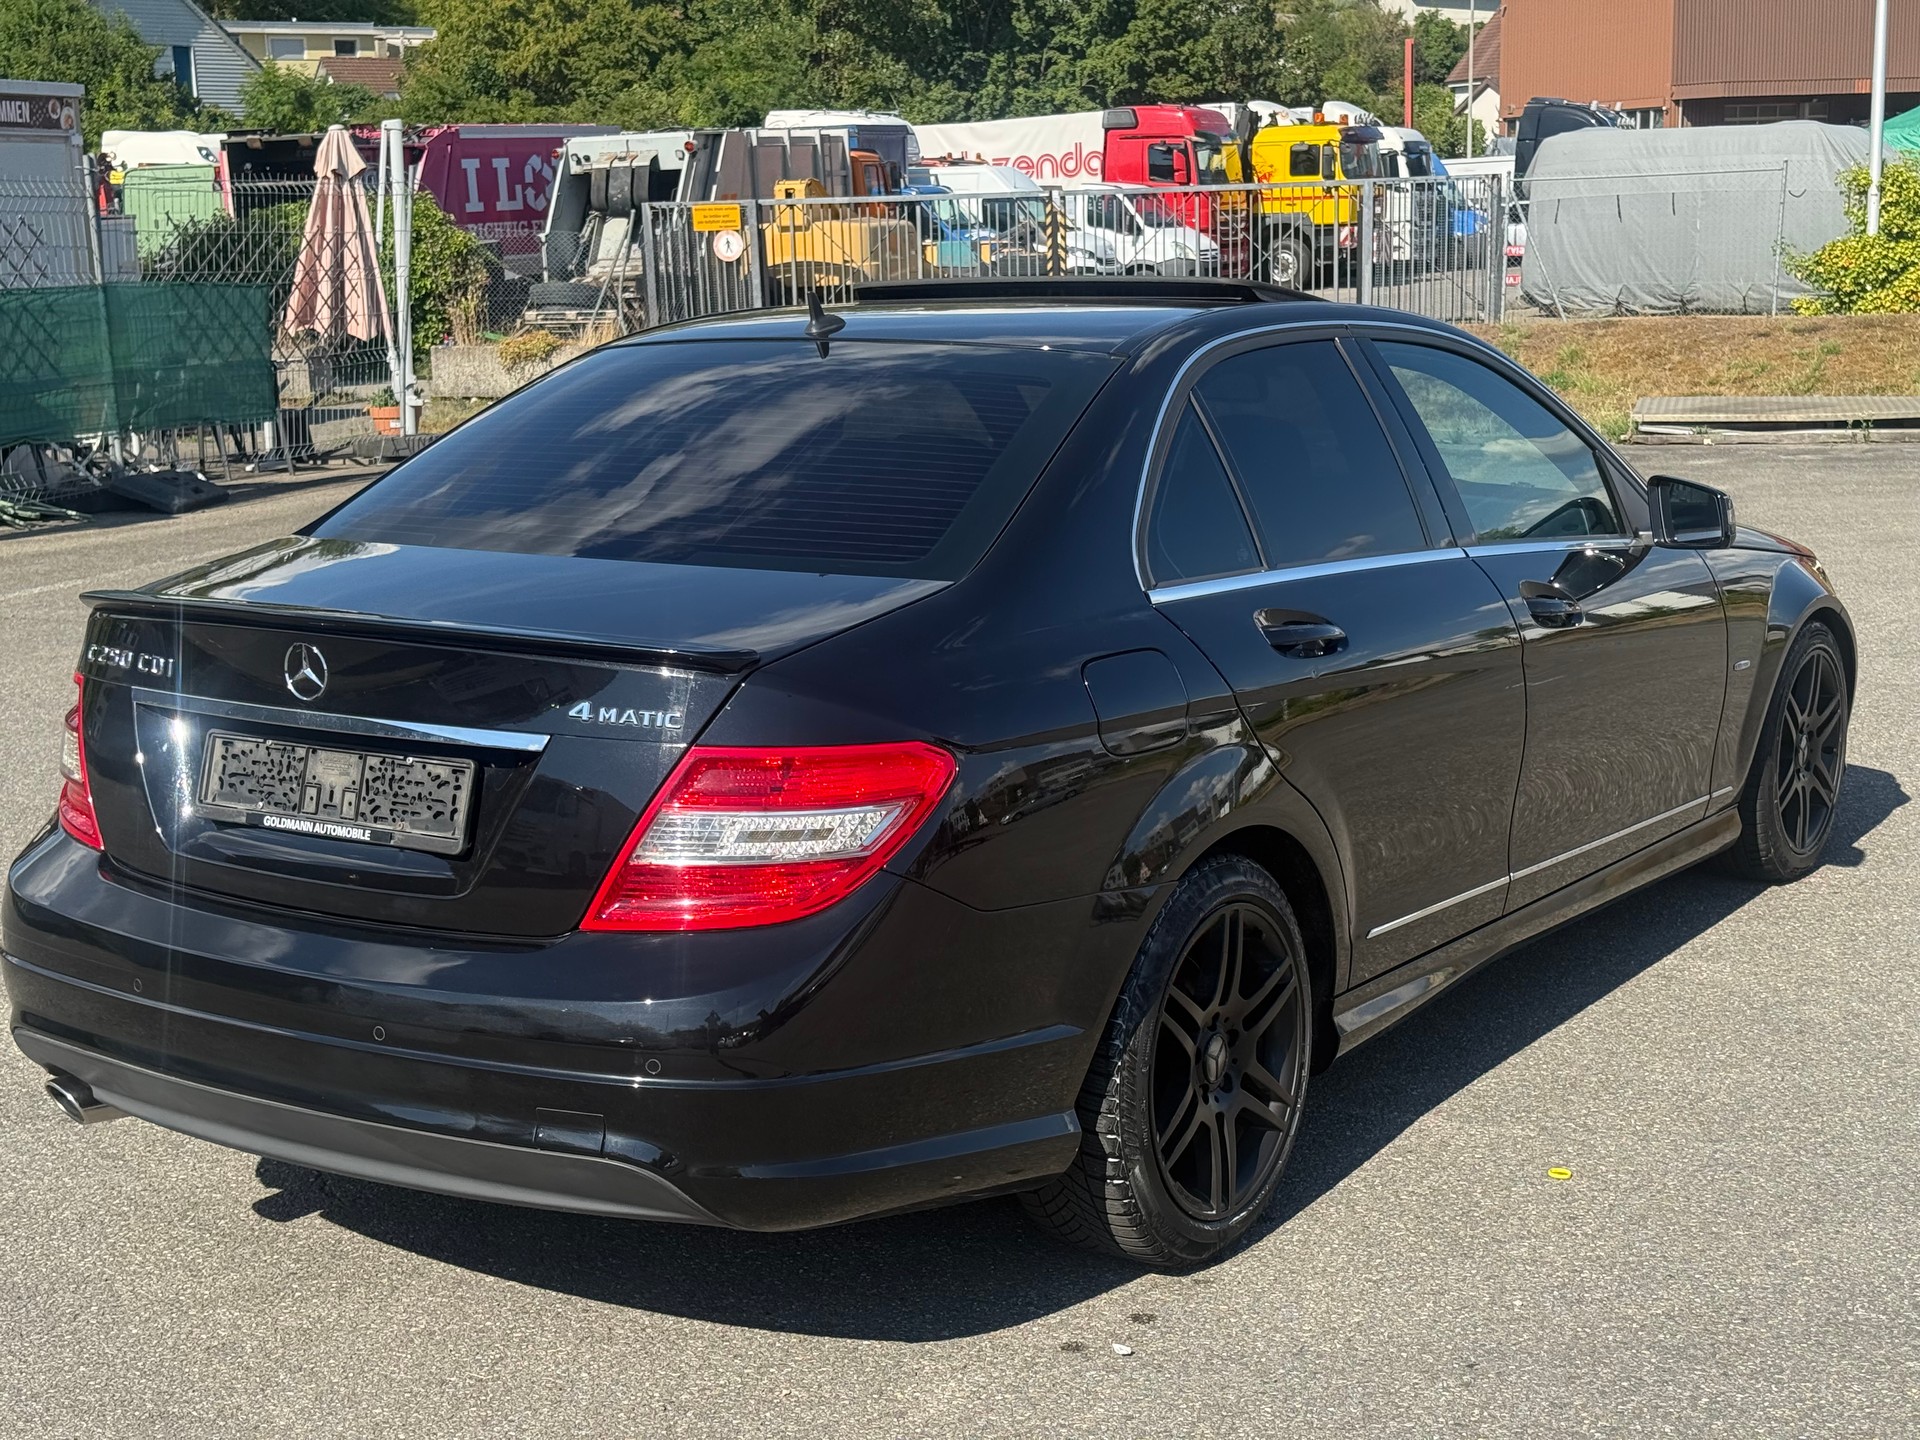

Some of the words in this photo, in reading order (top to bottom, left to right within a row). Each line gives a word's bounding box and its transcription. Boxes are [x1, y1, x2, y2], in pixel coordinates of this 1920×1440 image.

[962, 142, 1103, 179] zenda
[138, 653, 174, 677] CDI
[263, 815, 313, 832] GOLDMANN
[313, 822, 371, 841] AUTOMOBILE
